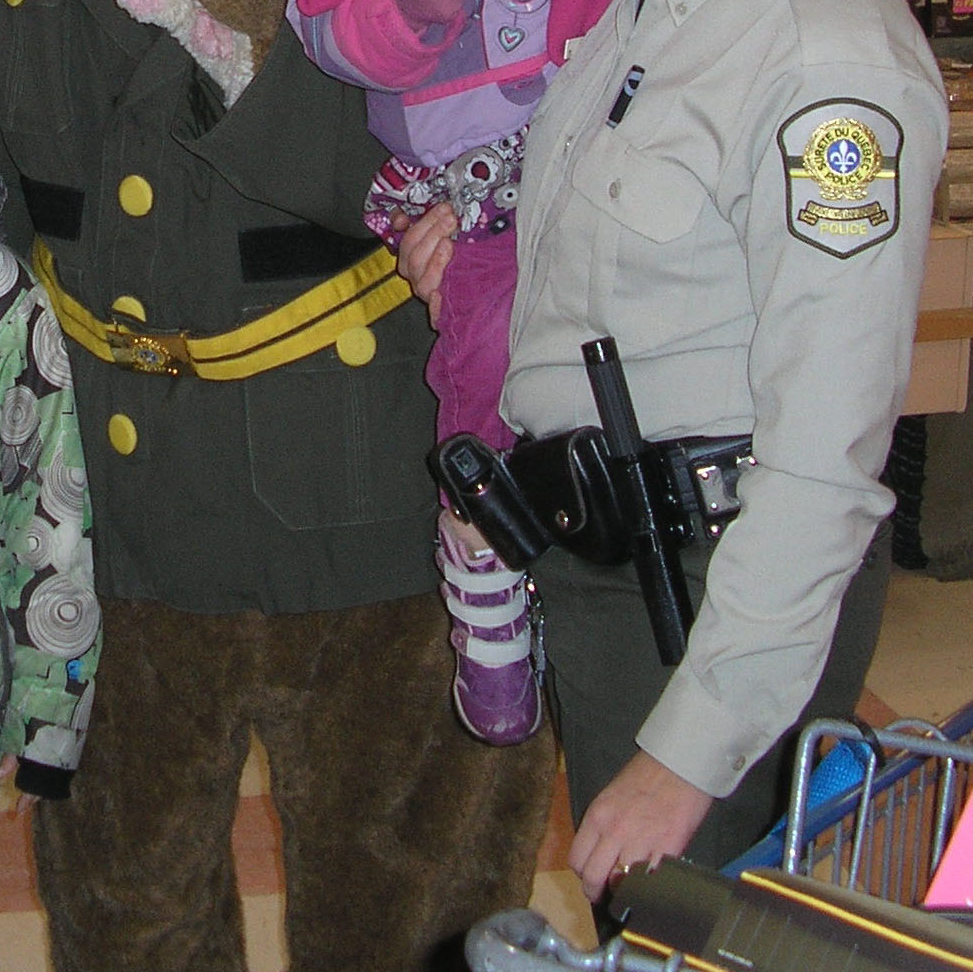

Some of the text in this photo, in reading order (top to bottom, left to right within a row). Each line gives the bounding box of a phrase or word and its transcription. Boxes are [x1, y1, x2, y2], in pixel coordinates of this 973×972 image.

[834, 127, 850, 138] DU
[825, 172, 862, 185] POLICE
[819, 222, 868, 235] POLICE
